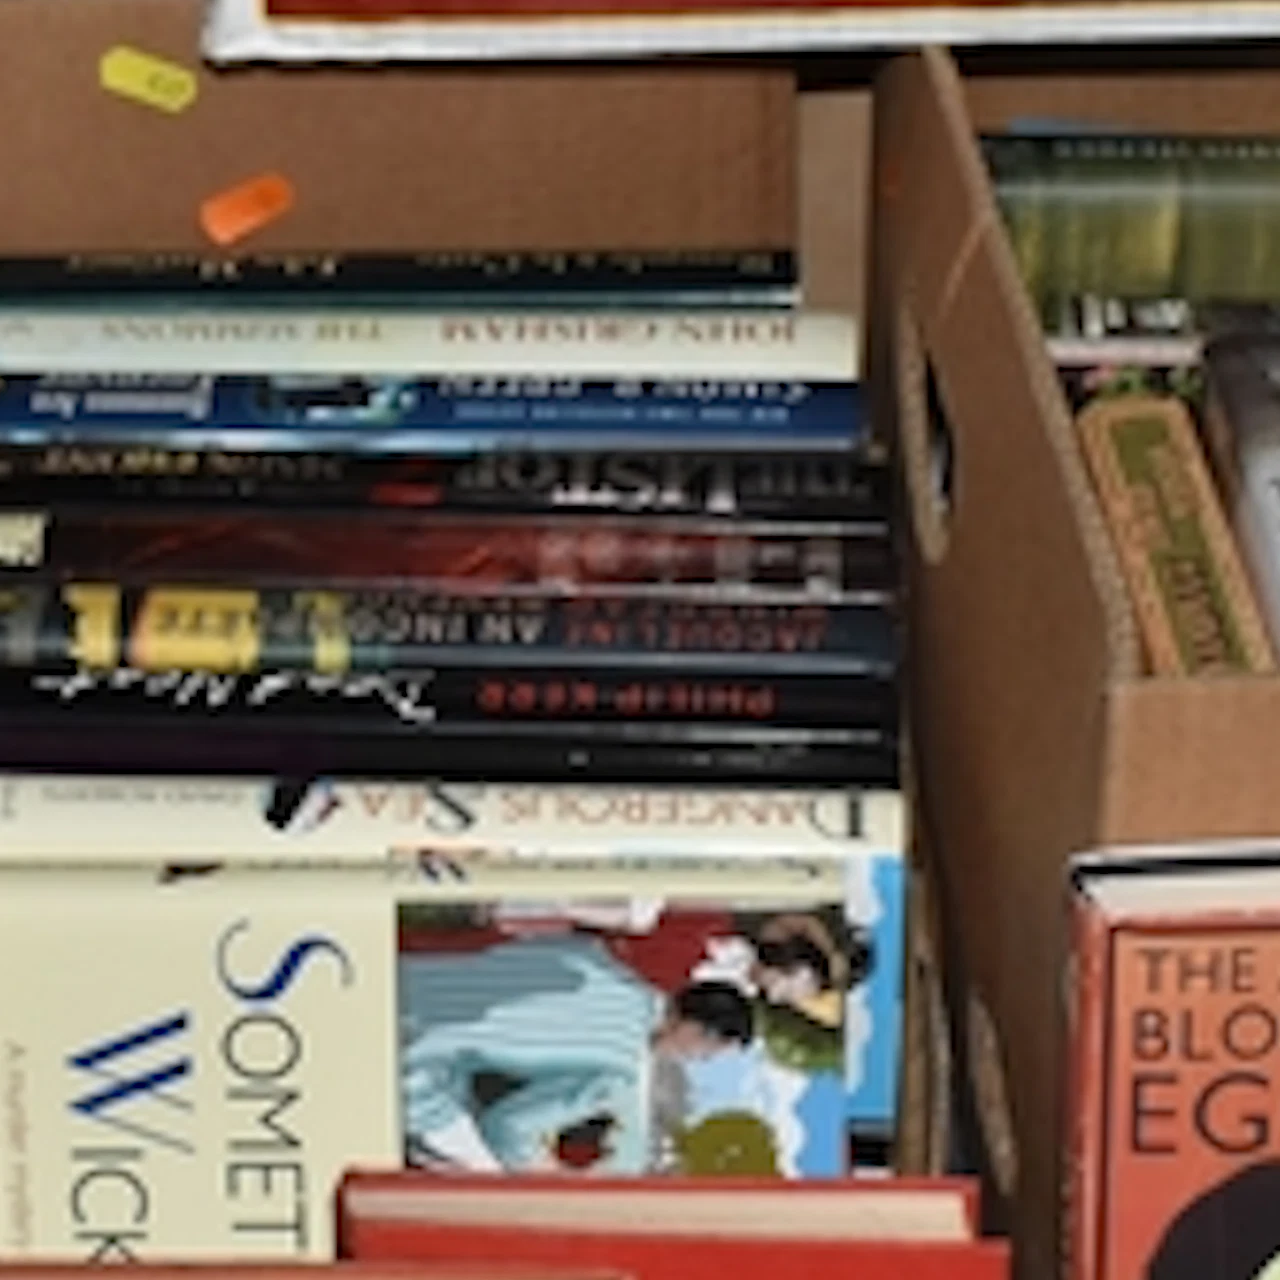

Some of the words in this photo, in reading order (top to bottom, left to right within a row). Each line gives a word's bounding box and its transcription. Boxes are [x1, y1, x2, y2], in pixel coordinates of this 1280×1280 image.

[440, 318, 658, 348] GRISHAM
[681, 317, 797, 346] JOHN
[474, 679, 597, 718] KERR
[613, 681, 780, 719] PHILIP
[500, 789, 871, 841] DANGEROUS
[1136, 946, 1258, 995] THE
